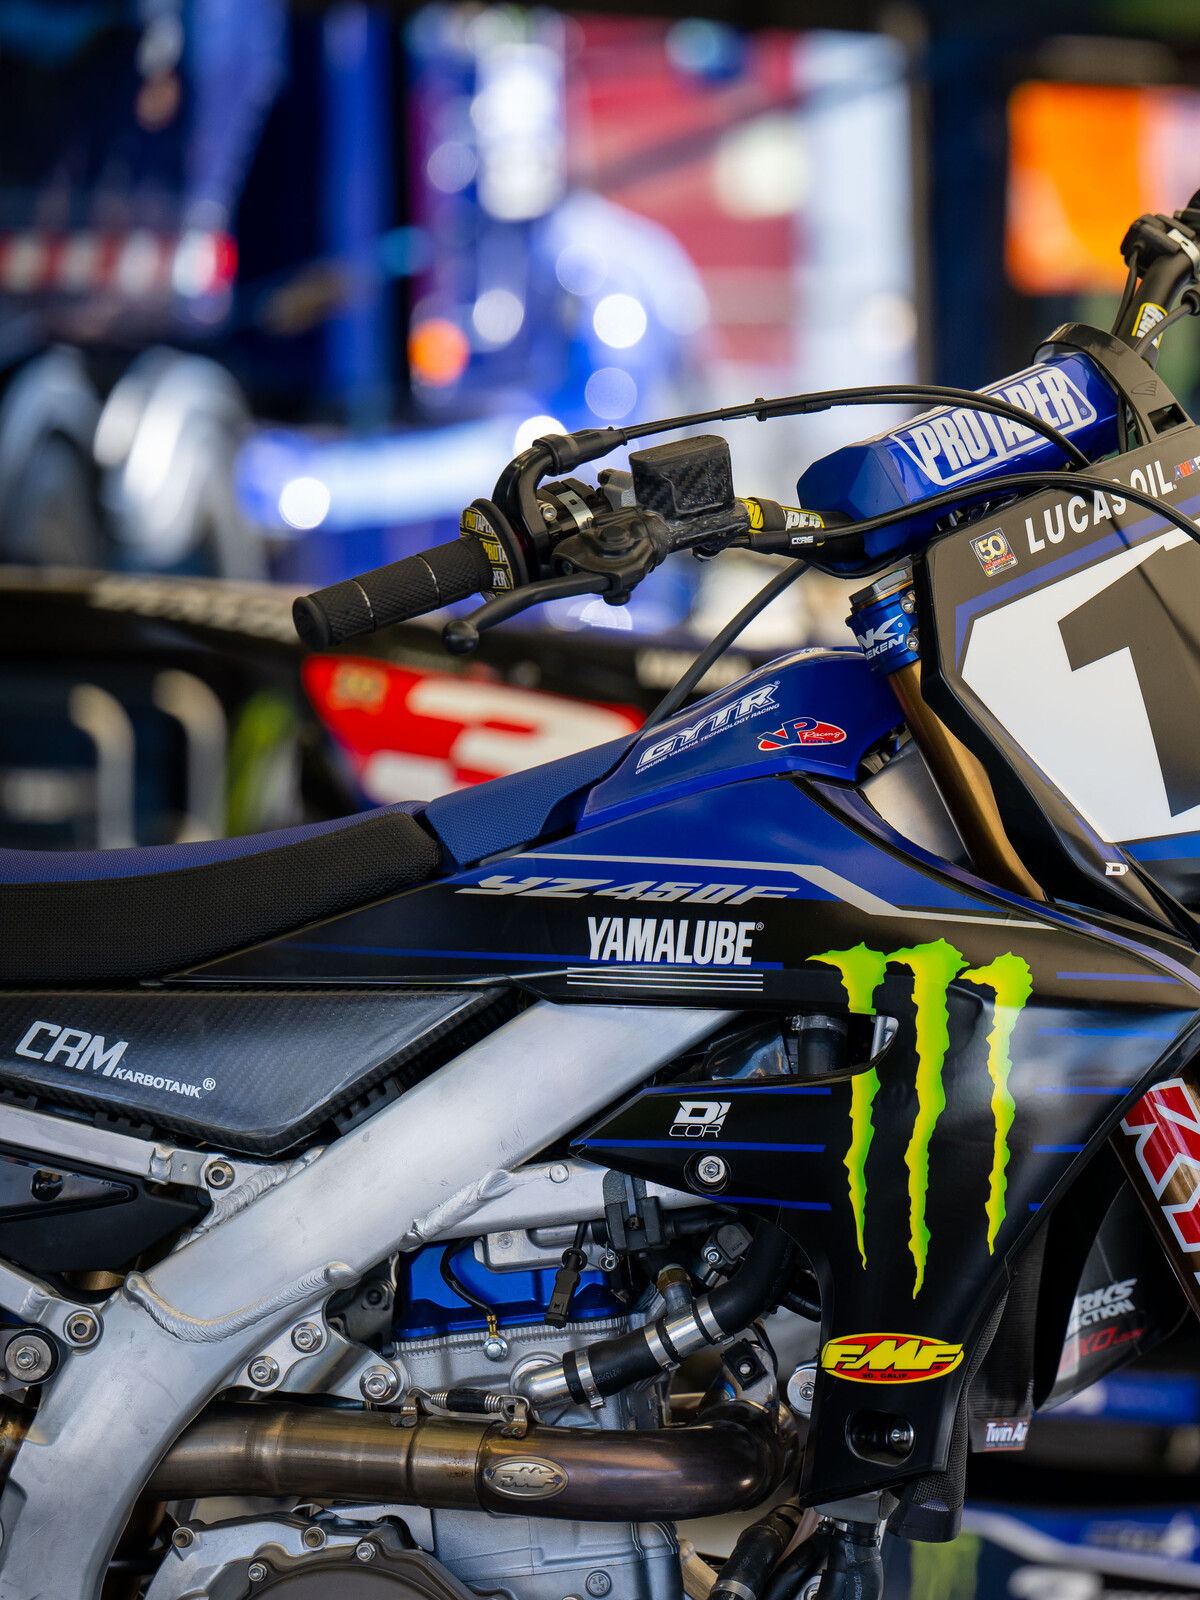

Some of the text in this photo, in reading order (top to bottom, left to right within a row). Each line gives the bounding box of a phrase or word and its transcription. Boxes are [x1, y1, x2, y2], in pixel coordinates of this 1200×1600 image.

[1025, 460, 1173, 554] LUCAS OIL
[792, 536, 813, 545] CORE
[977, 535, 1005, 560] 50
[635, 703, 780, 775] GENUINE YAMAHA TECHNOLOGY RACING
[637, 684, 779, 770] GYTR
[588, 917, 756, 966] YAMALUBE
[15, 1020, 202, 1099] CRM KARBOTANK
[668, 1123, 722, 1138] COR
[821, 1339, 964, 1371] FMF
[1011, 1421, 1029, 1442] Ai
